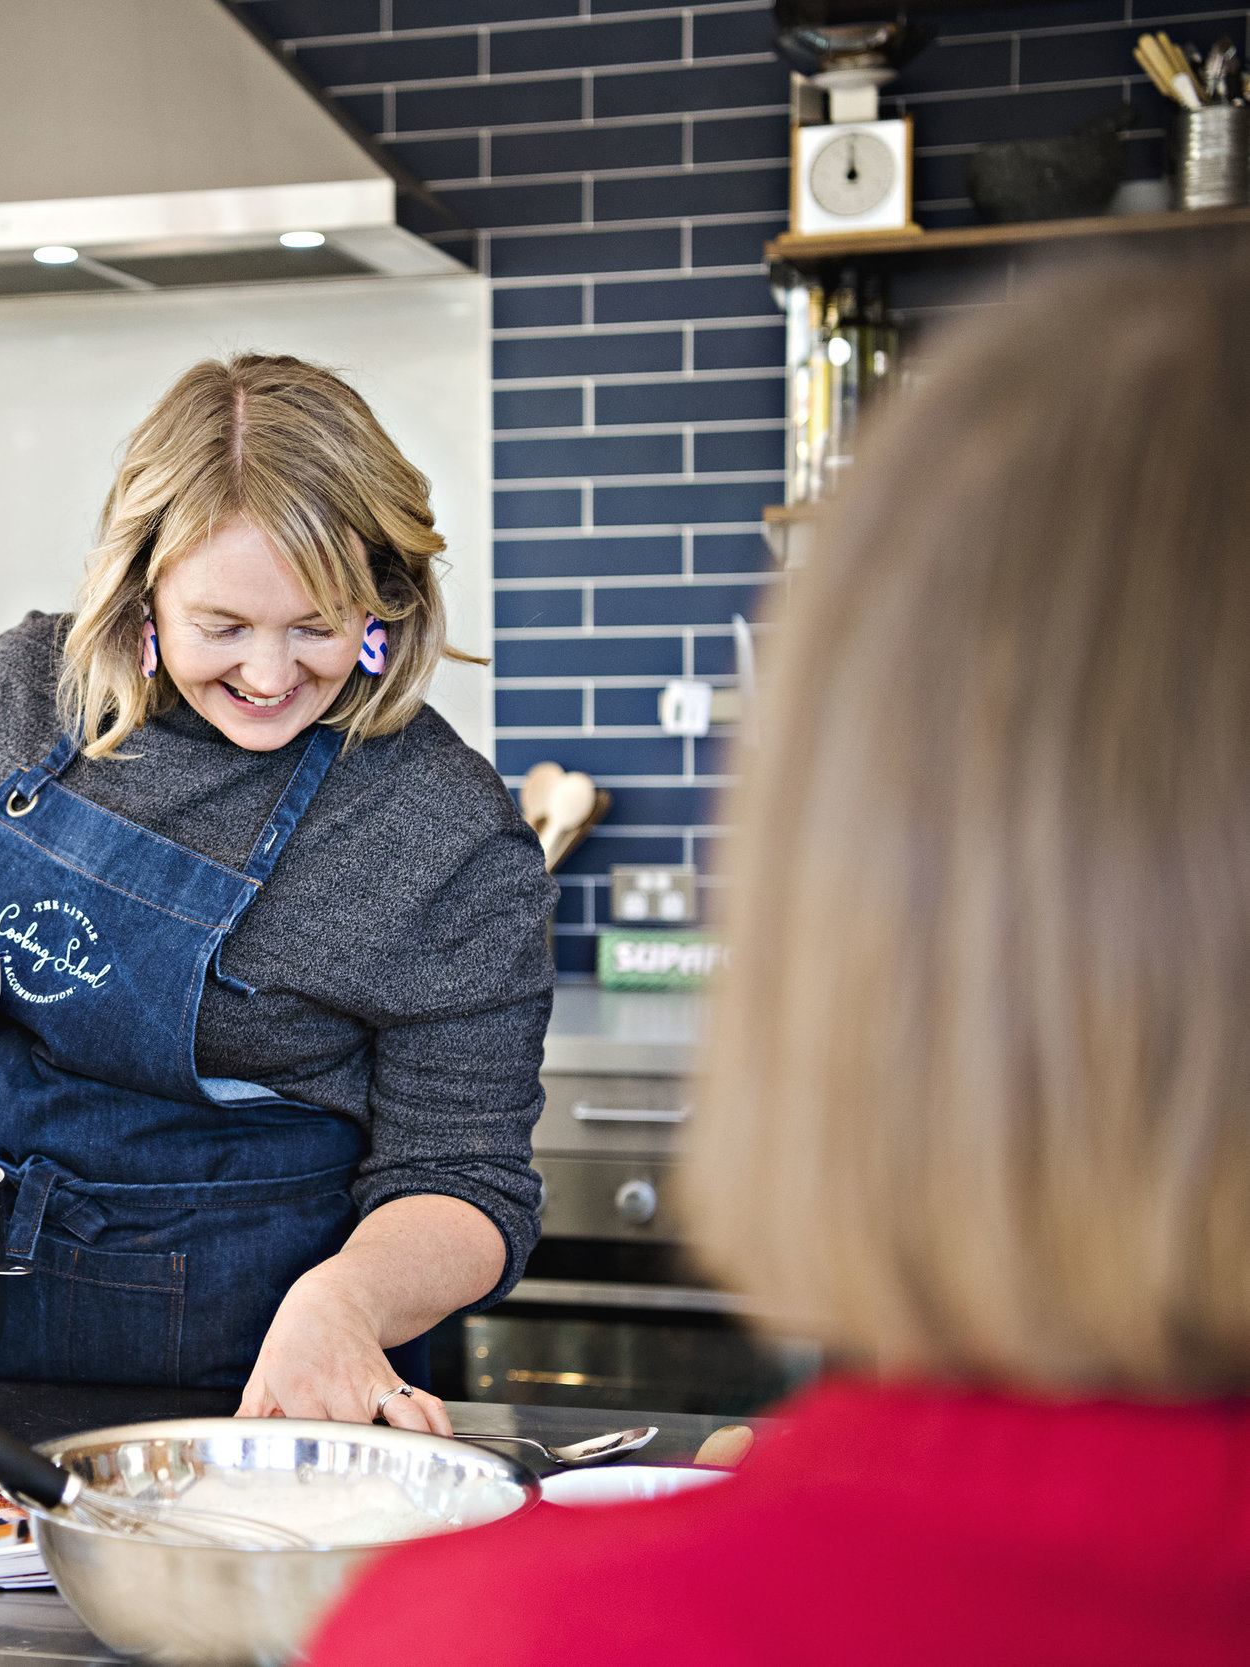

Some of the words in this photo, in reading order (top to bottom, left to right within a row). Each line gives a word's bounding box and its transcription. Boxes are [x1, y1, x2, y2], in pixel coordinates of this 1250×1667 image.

[34, 899, 60, 913] THE
[63, 902, 99, 942] LITTLE
[54, 937, 112, 989] School
[4, 966, 74, 1004] ACCOMMODATION
